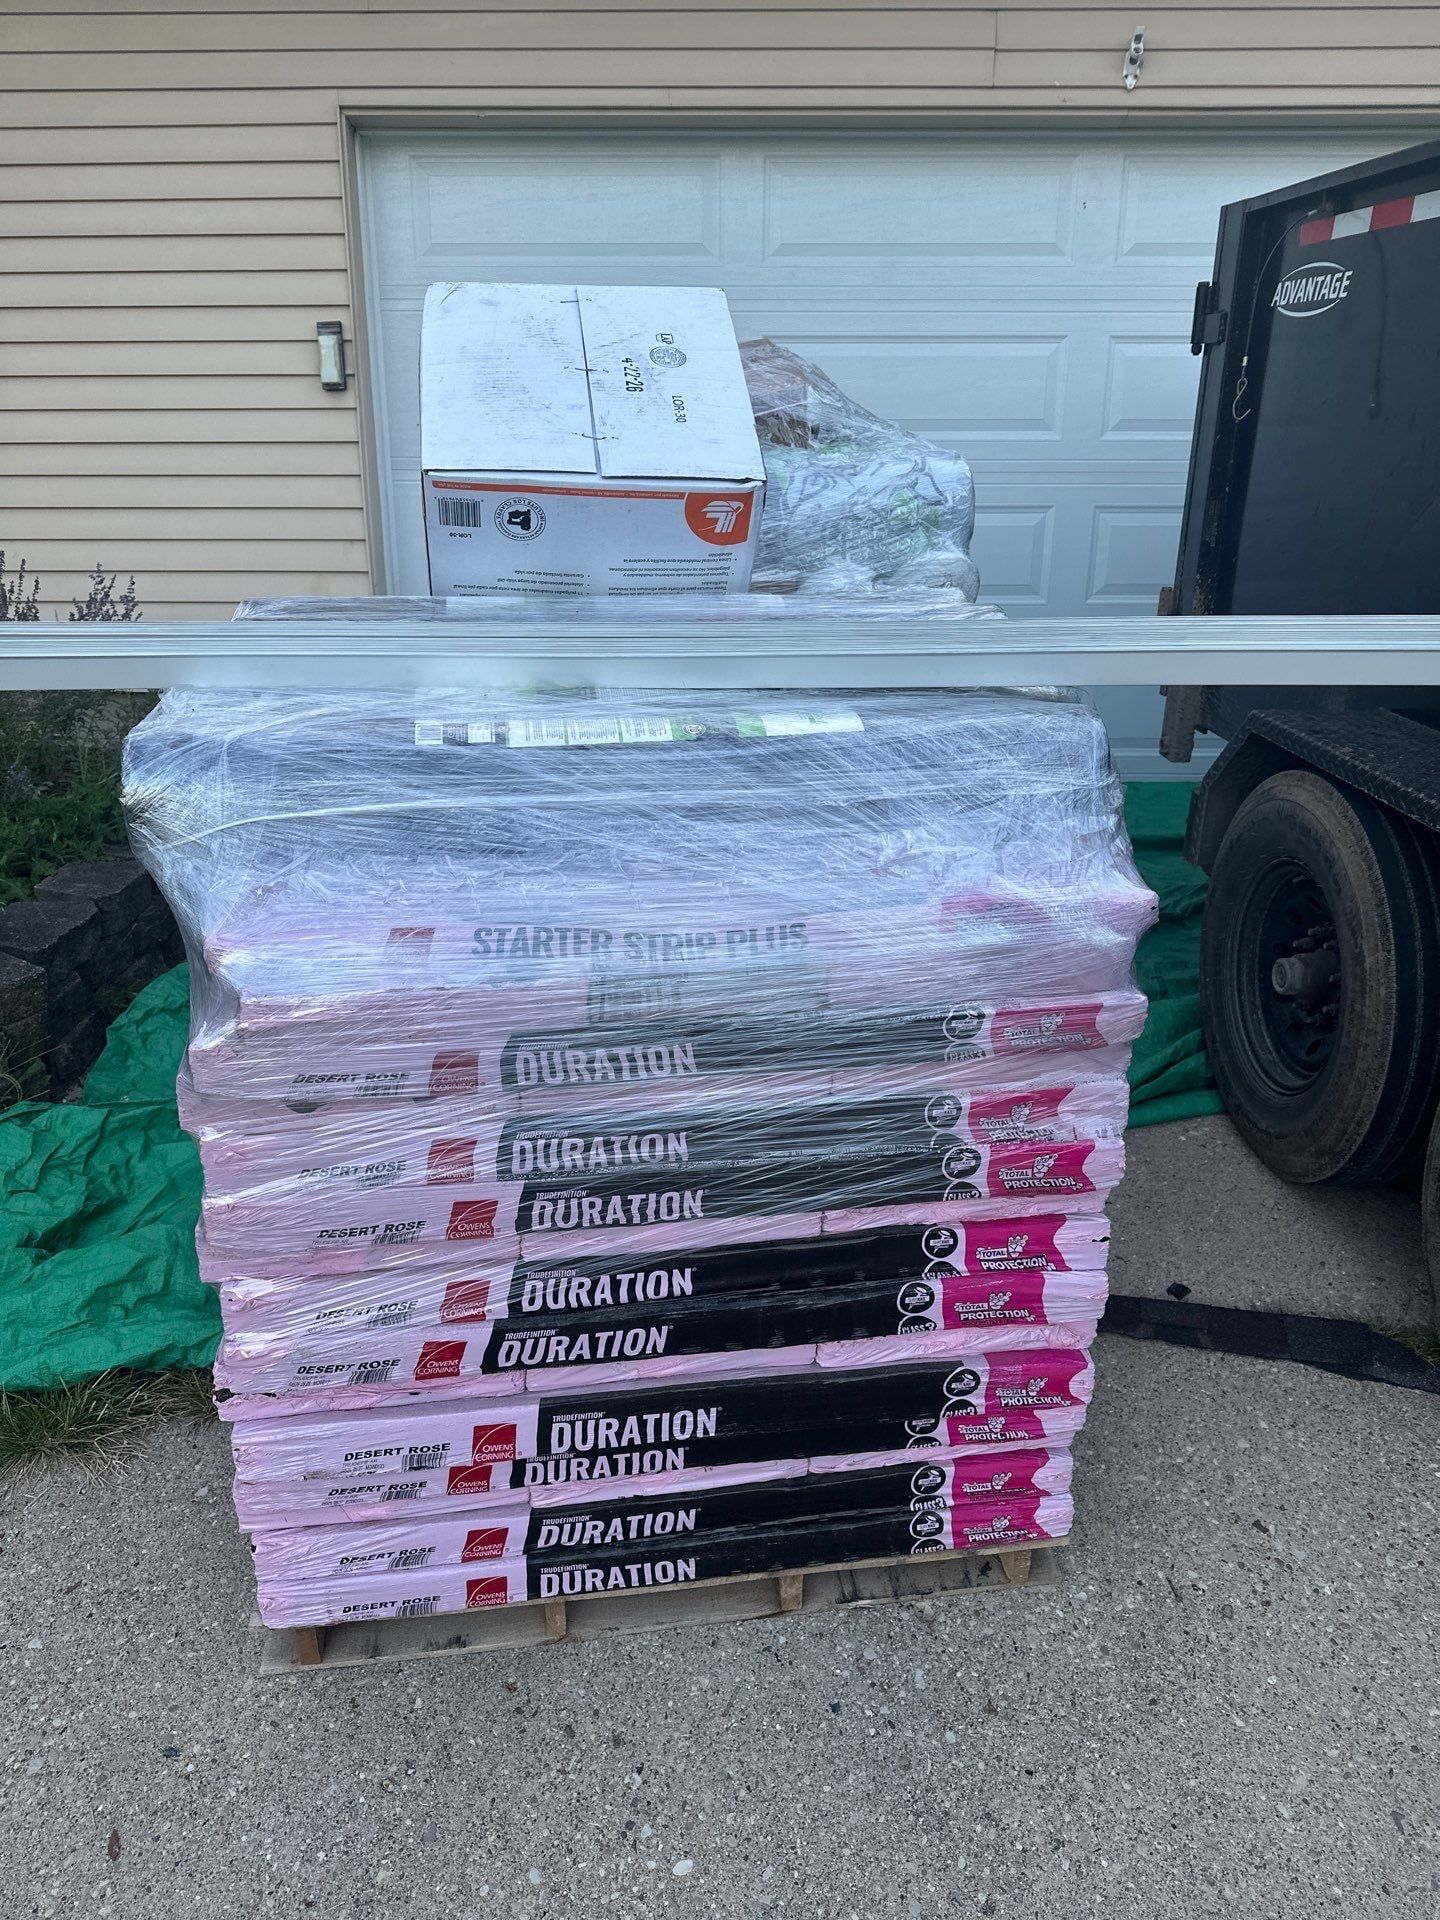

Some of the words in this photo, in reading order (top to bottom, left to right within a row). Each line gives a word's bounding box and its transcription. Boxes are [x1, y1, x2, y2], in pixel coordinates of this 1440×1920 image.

[1271, 271, 1353, 307] ADVANTAGE
[671, 395, 687, 423] LOR-30
[472, 927, 612, 958] STARTER
[623, 931, 717, 962] STRIP
[726, 922, 808, 953] PLUS
[1009, 1028, 1041, 1037] TOTAL
[1010, 1032, 1084, 1046] PROTECTION
[292, 1073, 359, 1084] DESERT
[437, 1074, 476, 1084] OWENS
[512, 1132, 688, 1174] DURATION
[298, 1164, 358, 1179] DESERT
[364, 1160, 406, 1174] ROSE
[1004, 1177, 1076, 1190] PROTECTION
[531, 1189, 704, 1232] DURATION
[317, 1224, 380, 1238] DESERT
[384, 1220, 428, 1233] ROSE
[457, 1222, 491, 1232] OWENS
[449, 1229, 491, 1238] CORNING
[981, 1250, 1007, 1258] TOTAL
[981, 1257, 1048, 1271] PROTECTION
[521, 1267, 693, 1312] DURATION
[315, 1306, 374, 1321] DESERT
[377, 1299, 419, 1313] ROSE
[443, 1307, 483, 1318] CORNING
[960, 1309, 1030, 1321] PROTECTION
[504, 1329, 556, 1340] TRUDEFINITION
[497, 1325, 669, 1368] DURATION
[296, 1363, 351, 1375] DESERT
[358, 1358, 400, 1369] ROSE
[427, 1359, 460, 1368] OWENS
[417, 1366, 459, 1375] CORNING
[1001, 1396, 1063, 1407] PROTECTION
[552, 1411, 603, 1422] TRUDEFINITION
[551, 1407, 717, 1454] DURATION
[964, 1431, 1029, 1441] PROTECTION
[344, 1447, 404, 1462] DESERT
[408, 1442, 451, 1454] ROSE
[481, 1443, 514, 1453] OWENS
[475, 1451, 515, 1462] CORNING
[524, 1447, 684, 1487] DURATION
[328, 1484, 382, 1497] DESERT
[388, 1480, 428, 1491] ROSE
[457, 1480, 488, 1488] OWENS
[450, 1486, 488, 1495] CORNING
[542, 1515, 590, 1525] TRUDEFINITION
[537, 1509, 697, 1549] DURATION
[472, 1543, 503, 1553] OWENS
[339, 1551, 394, 1565] DESERT
[399, 1546, 436, 1557] ROSE
[464, 1550, 502, 1559] CORNING
[540, 1558, 696, 1598] DURATION
[475, 1592, 505, 1600] OWENS
[342, 1600, 398, 1614] DESERT
[402, 1595, 442, 1605] ROSE
[469, 1599, 507, 1607] CORNING
